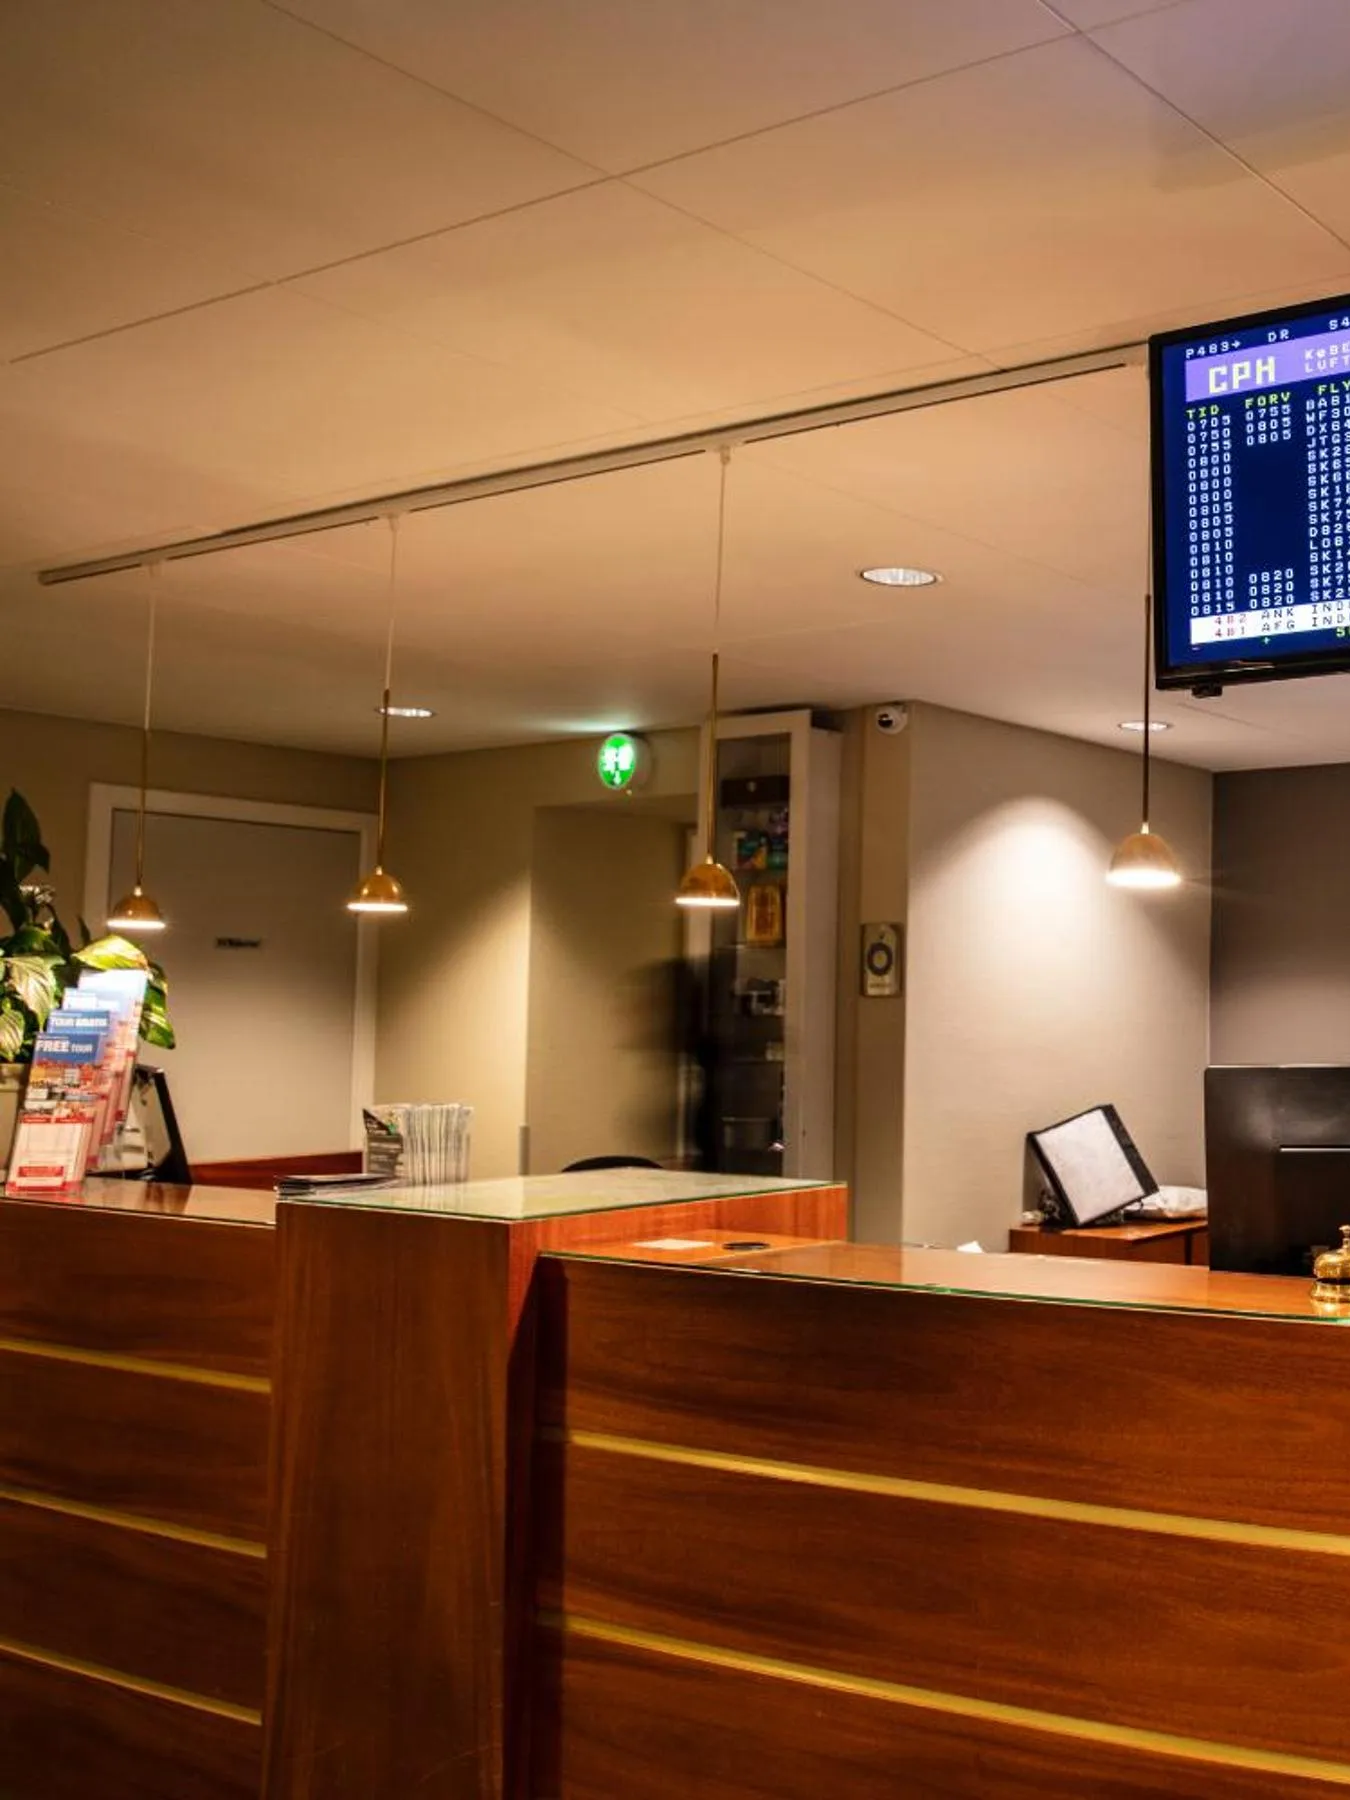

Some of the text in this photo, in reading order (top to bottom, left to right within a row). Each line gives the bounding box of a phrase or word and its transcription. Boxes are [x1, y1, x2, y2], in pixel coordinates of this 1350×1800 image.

[1268, 329, 1289, 342] DR
[1209, 355, 1276, 394] CPH
[1186, 405, 1219, 419] TID
[1245, 392, 1290, 409] FORV
[1187, 415, 1231, 432] 0705
[1246, 404, 1291, 421] 0755
[1187, 428, 1230, 444] 0750
[1246, 417, 1291, 434] 0805
[1188, 439, 1232, 456] 0755
[1246, 429, 1291, 446] 0805
[1188, 452, 1231, 469] 0800
[1188, 464, 1231, 481] 0800
[1188, 476, 1232, 493] 0800
[1189, 489, 1232, 505] 0800
[1189, 501, 1233, 517] 0805
[1189, 514, 1233, 530] 0805
[1189, 527, 1233, 542] 0805
[1190, 539, 1233, 555] 0810
[1190, 552, 1233, 567] 0810
[1190, 564, 1233, 579] 0810
[1191, 576, 1234, 592] 0810
[1249, 568, 1294, 584] 0820
[1191, 589, 1234, 604] 0810
[1249, 581, 1294, 596] 0820
[1191, 601, 1235, 616] 0815
[1249, 594, 1294, 609] 0820
[1262, 606, 1295, 620] ANK
[1262, 619, 1296, 633] AFG
[36, 1038, 69, 1053] FREE
